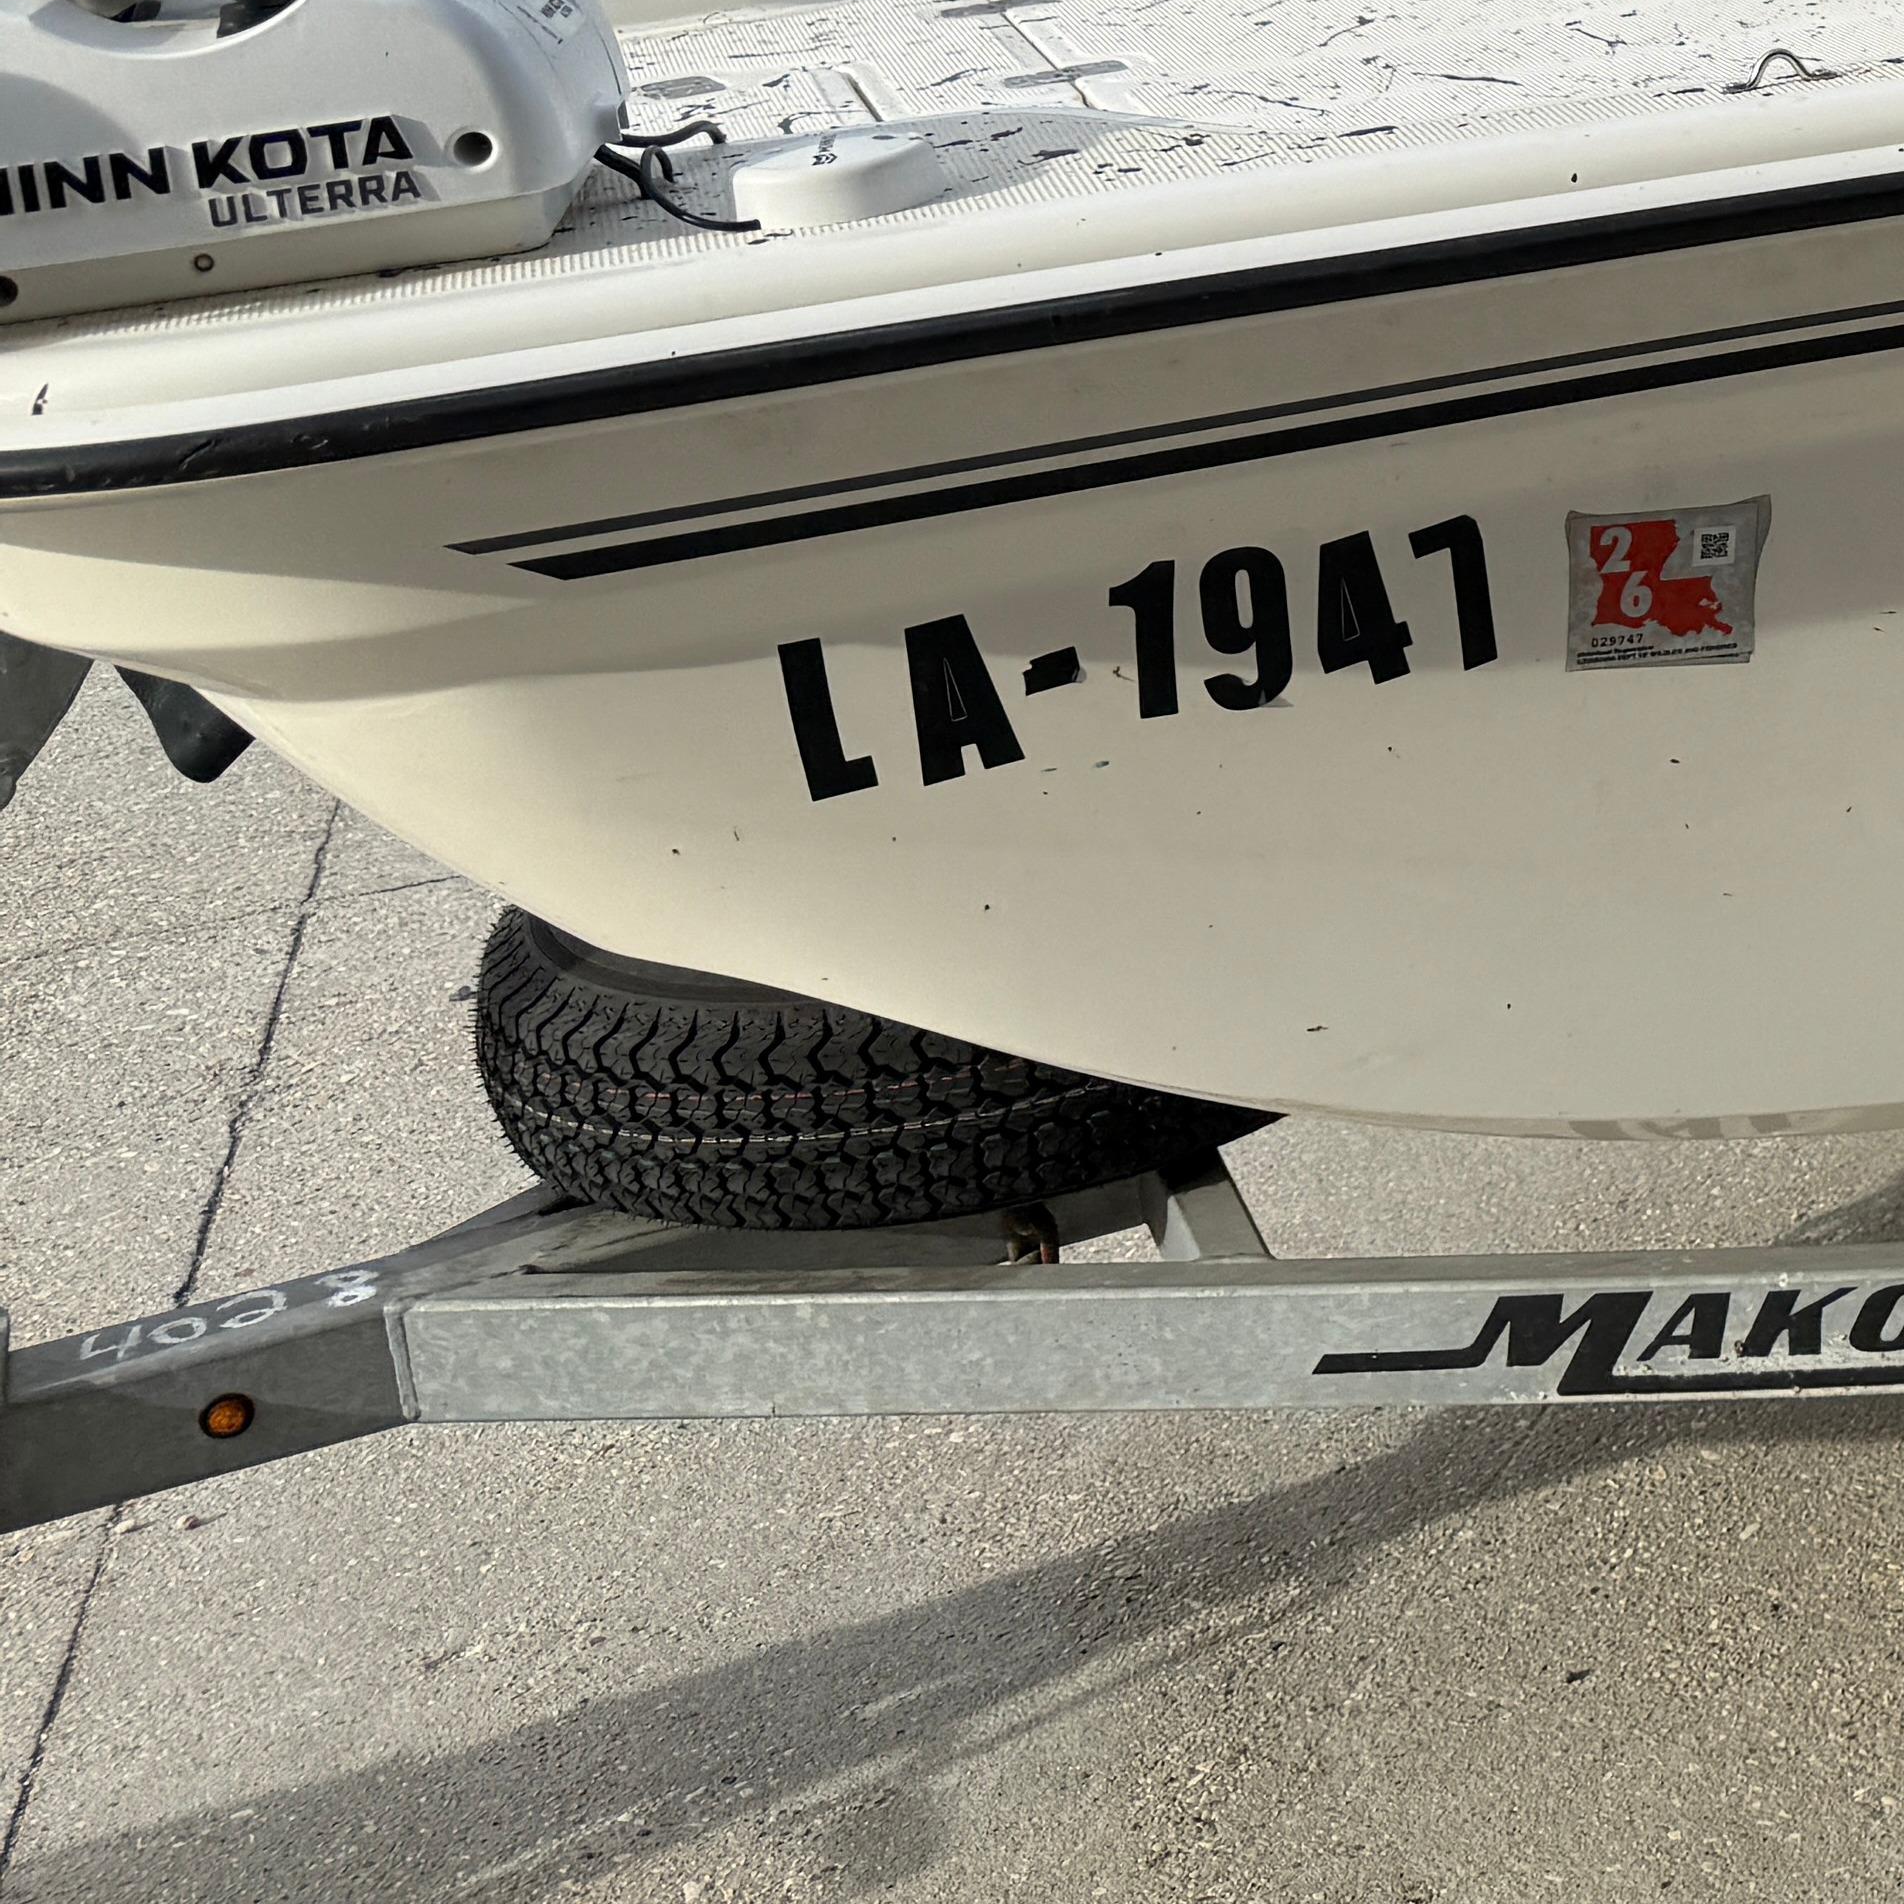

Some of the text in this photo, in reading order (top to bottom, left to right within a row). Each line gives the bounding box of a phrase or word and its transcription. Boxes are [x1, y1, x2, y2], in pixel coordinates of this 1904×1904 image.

[0, 116, 413, 216] INN KOTA
[208, 171, 421, 228] ULTERRA
[1591, 633, 1643, 648] 029747
